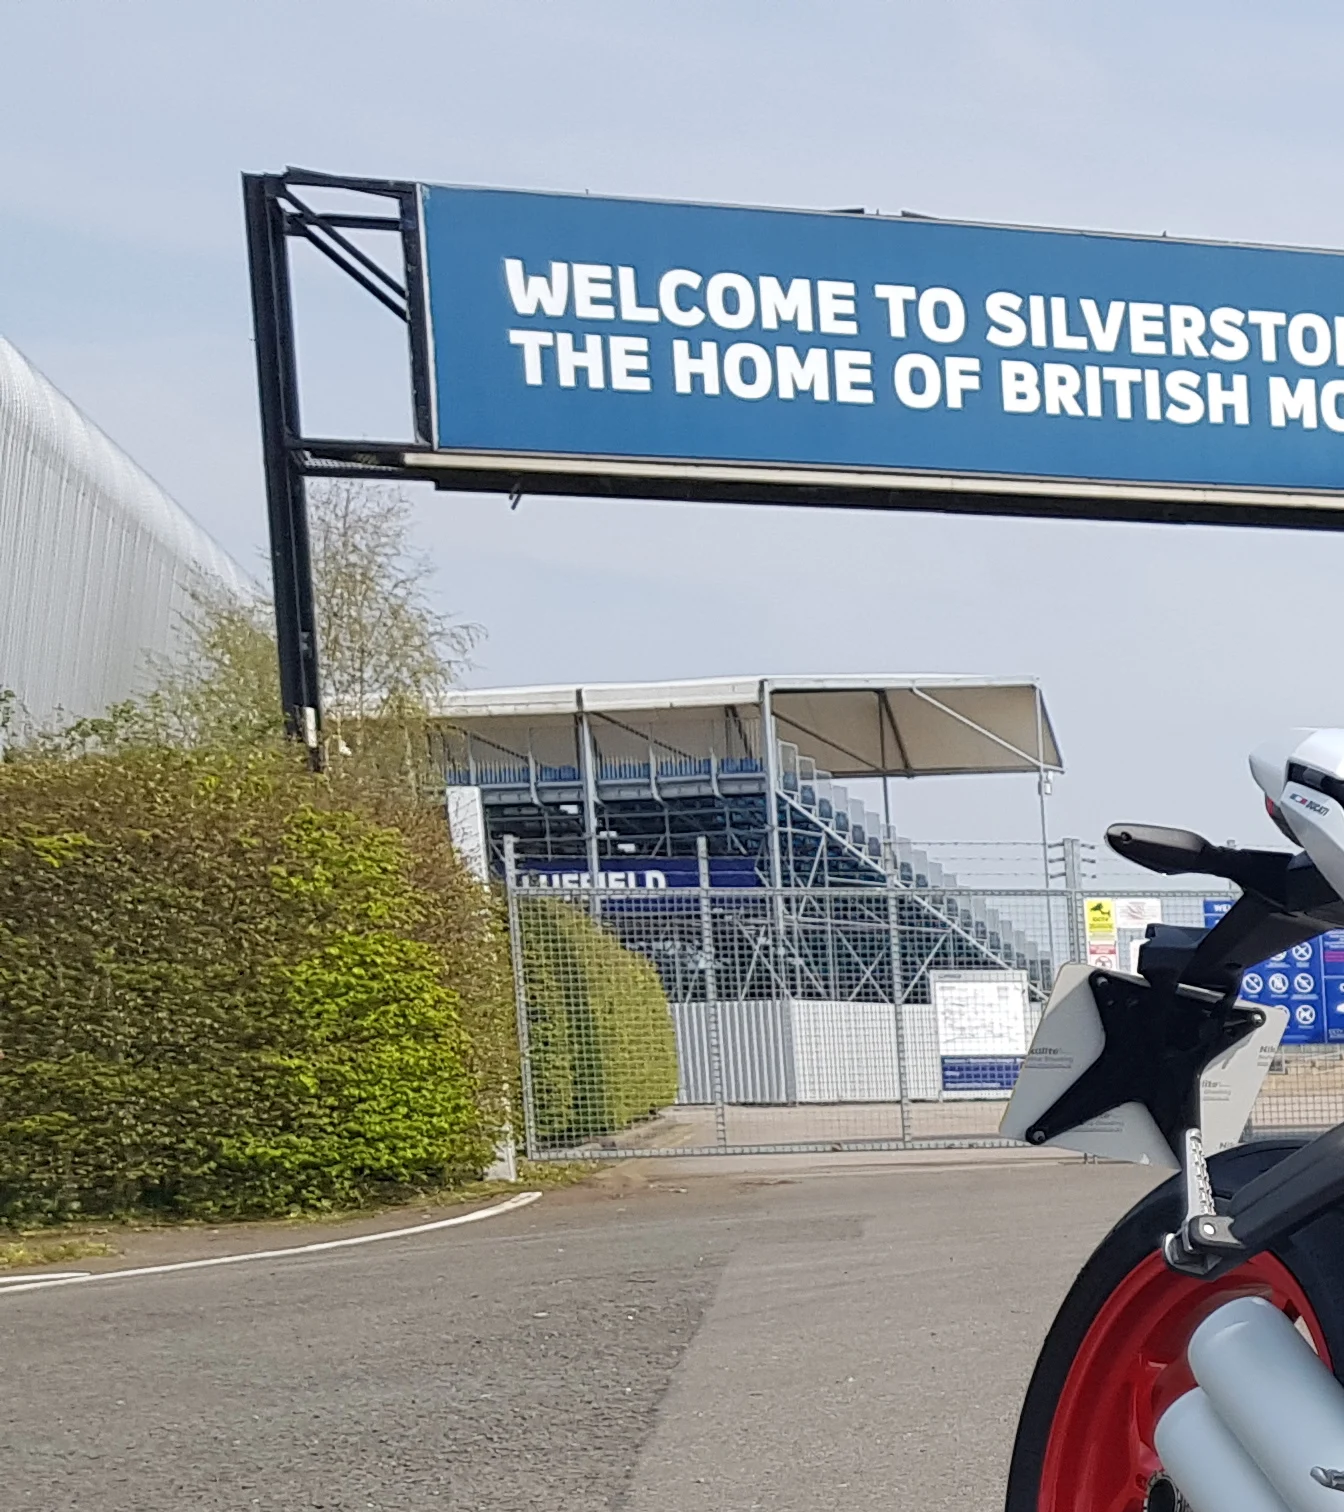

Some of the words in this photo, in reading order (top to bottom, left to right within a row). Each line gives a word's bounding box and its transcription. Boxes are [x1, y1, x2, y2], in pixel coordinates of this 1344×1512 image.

[504, 257, 858, 336] WELCOME
[874, 282, 966, 345] TO
[508, 328, 653, 393] THE
[672, 340, 874, 404] HOME
[893, 352, 982, 411] OF
[1001, 359, 1250, 427] BRITISH
[1305, 800, 1330, 817] DUCATI
